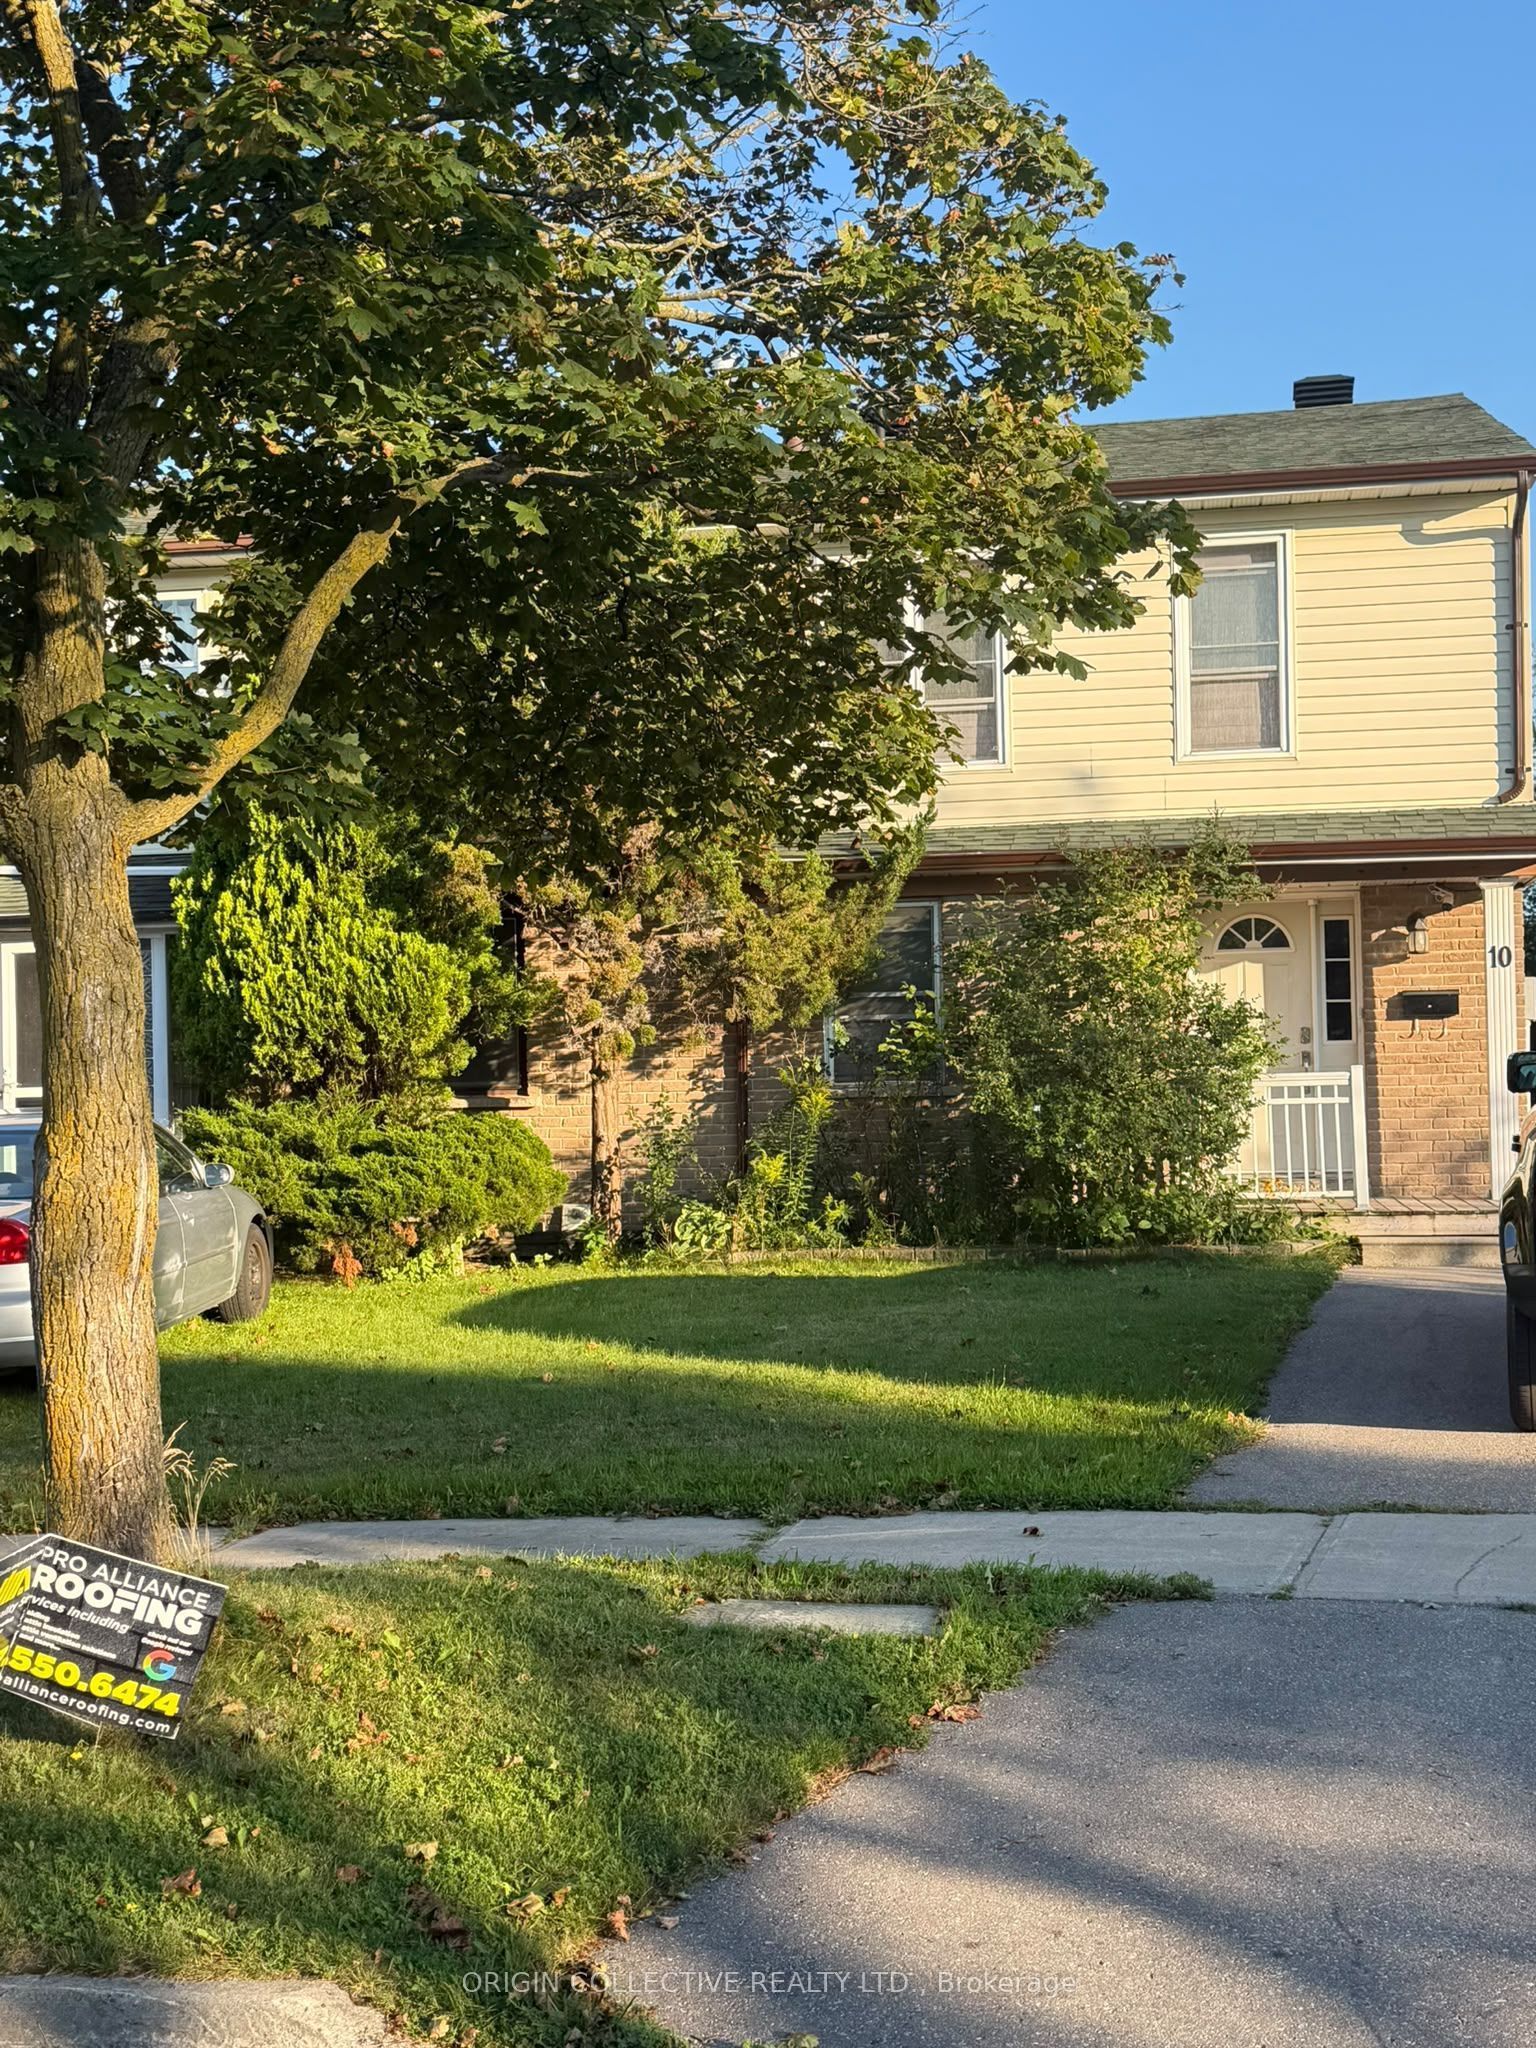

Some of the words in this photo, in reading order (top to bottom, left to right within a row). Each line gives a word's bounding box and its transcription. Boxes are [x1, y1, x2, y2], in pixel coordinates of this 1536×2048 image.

[1488, 946, 1512, 968] 10
[31, 1563, 204, 1635] ROOFING
[41, 1546, 87, 1572] PRO
[91, 1563, 210, 1610] ALLIANCE
[67, 1606, 130, 1634] including
[0, 1673, 170, 1733] allianceroofing.com
